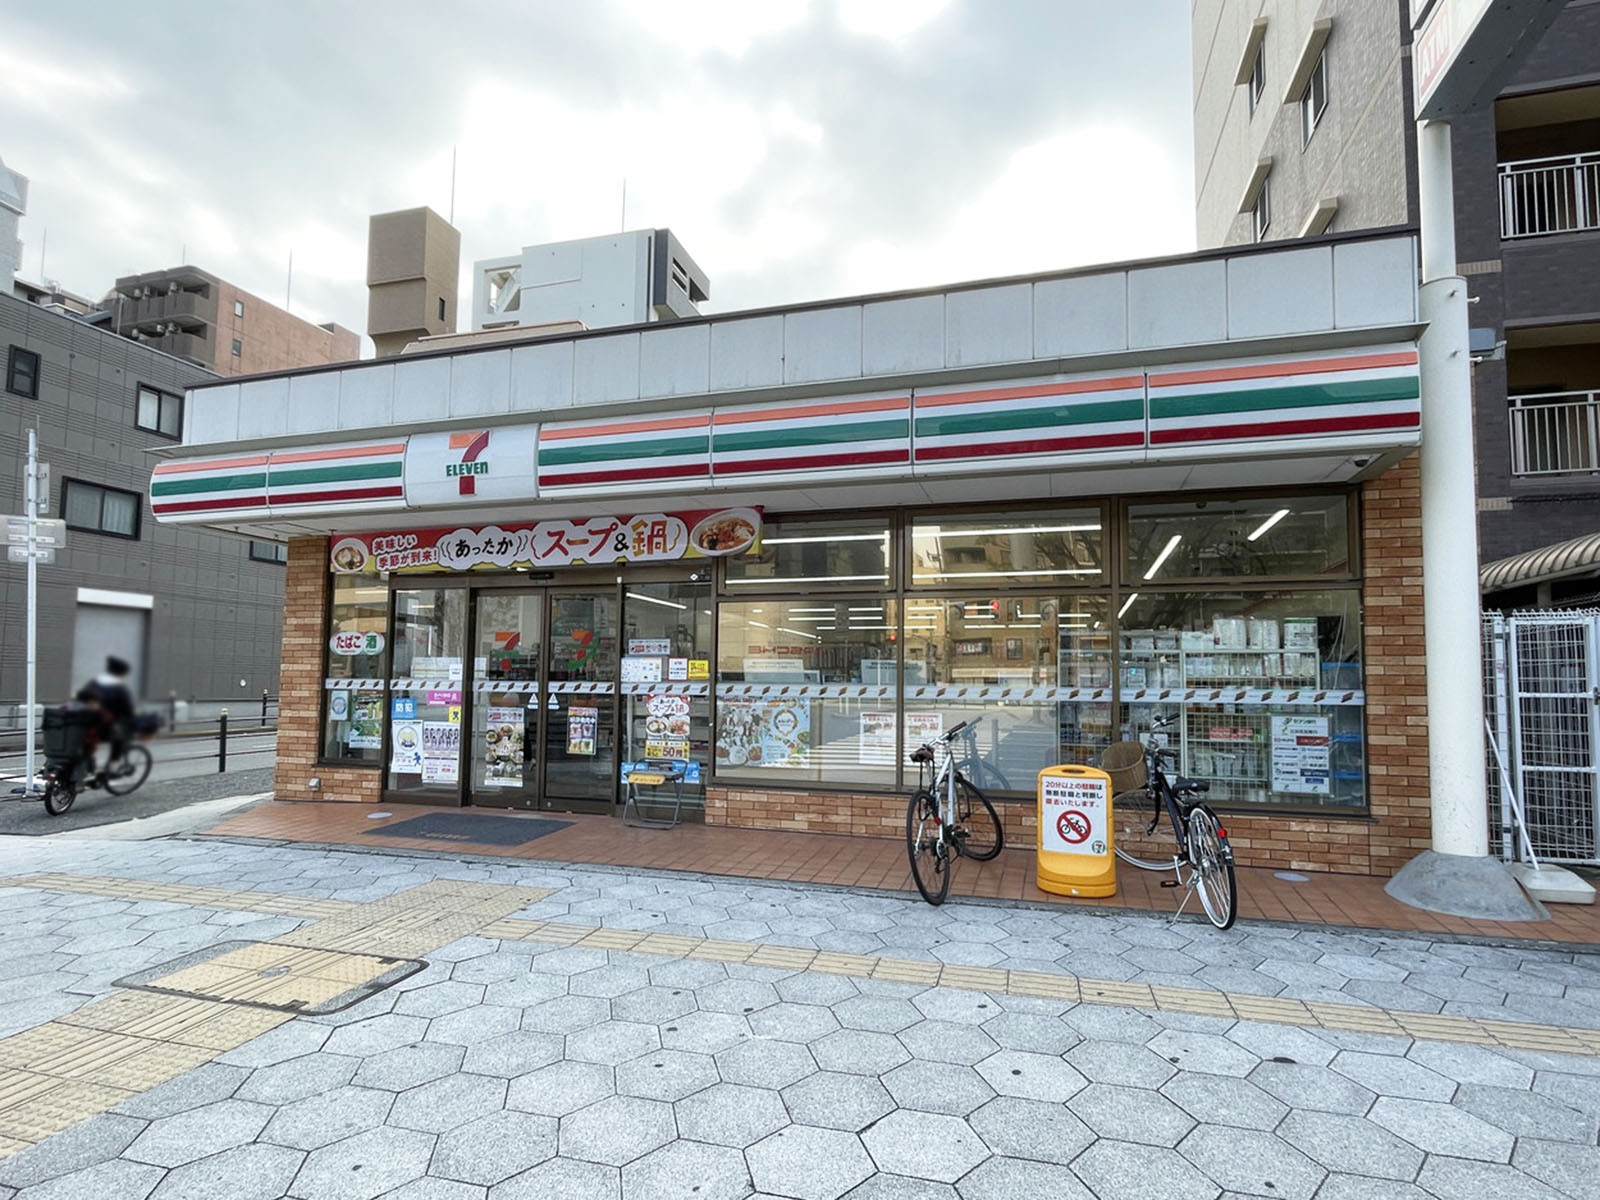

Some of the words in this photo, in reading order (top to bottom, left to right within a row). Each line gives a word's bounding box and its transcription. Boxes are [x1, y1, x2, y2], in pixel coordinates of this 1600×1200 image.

[1421, 14, 1449, 89] ATM
[449, 430, 490, 495] 7
[373, 535, 416, 553] 美味しい
[455, 536, 514, 558] あったか
[336, 635, 361, 649] たばこ
[365, 635, 378, 649] 酒
